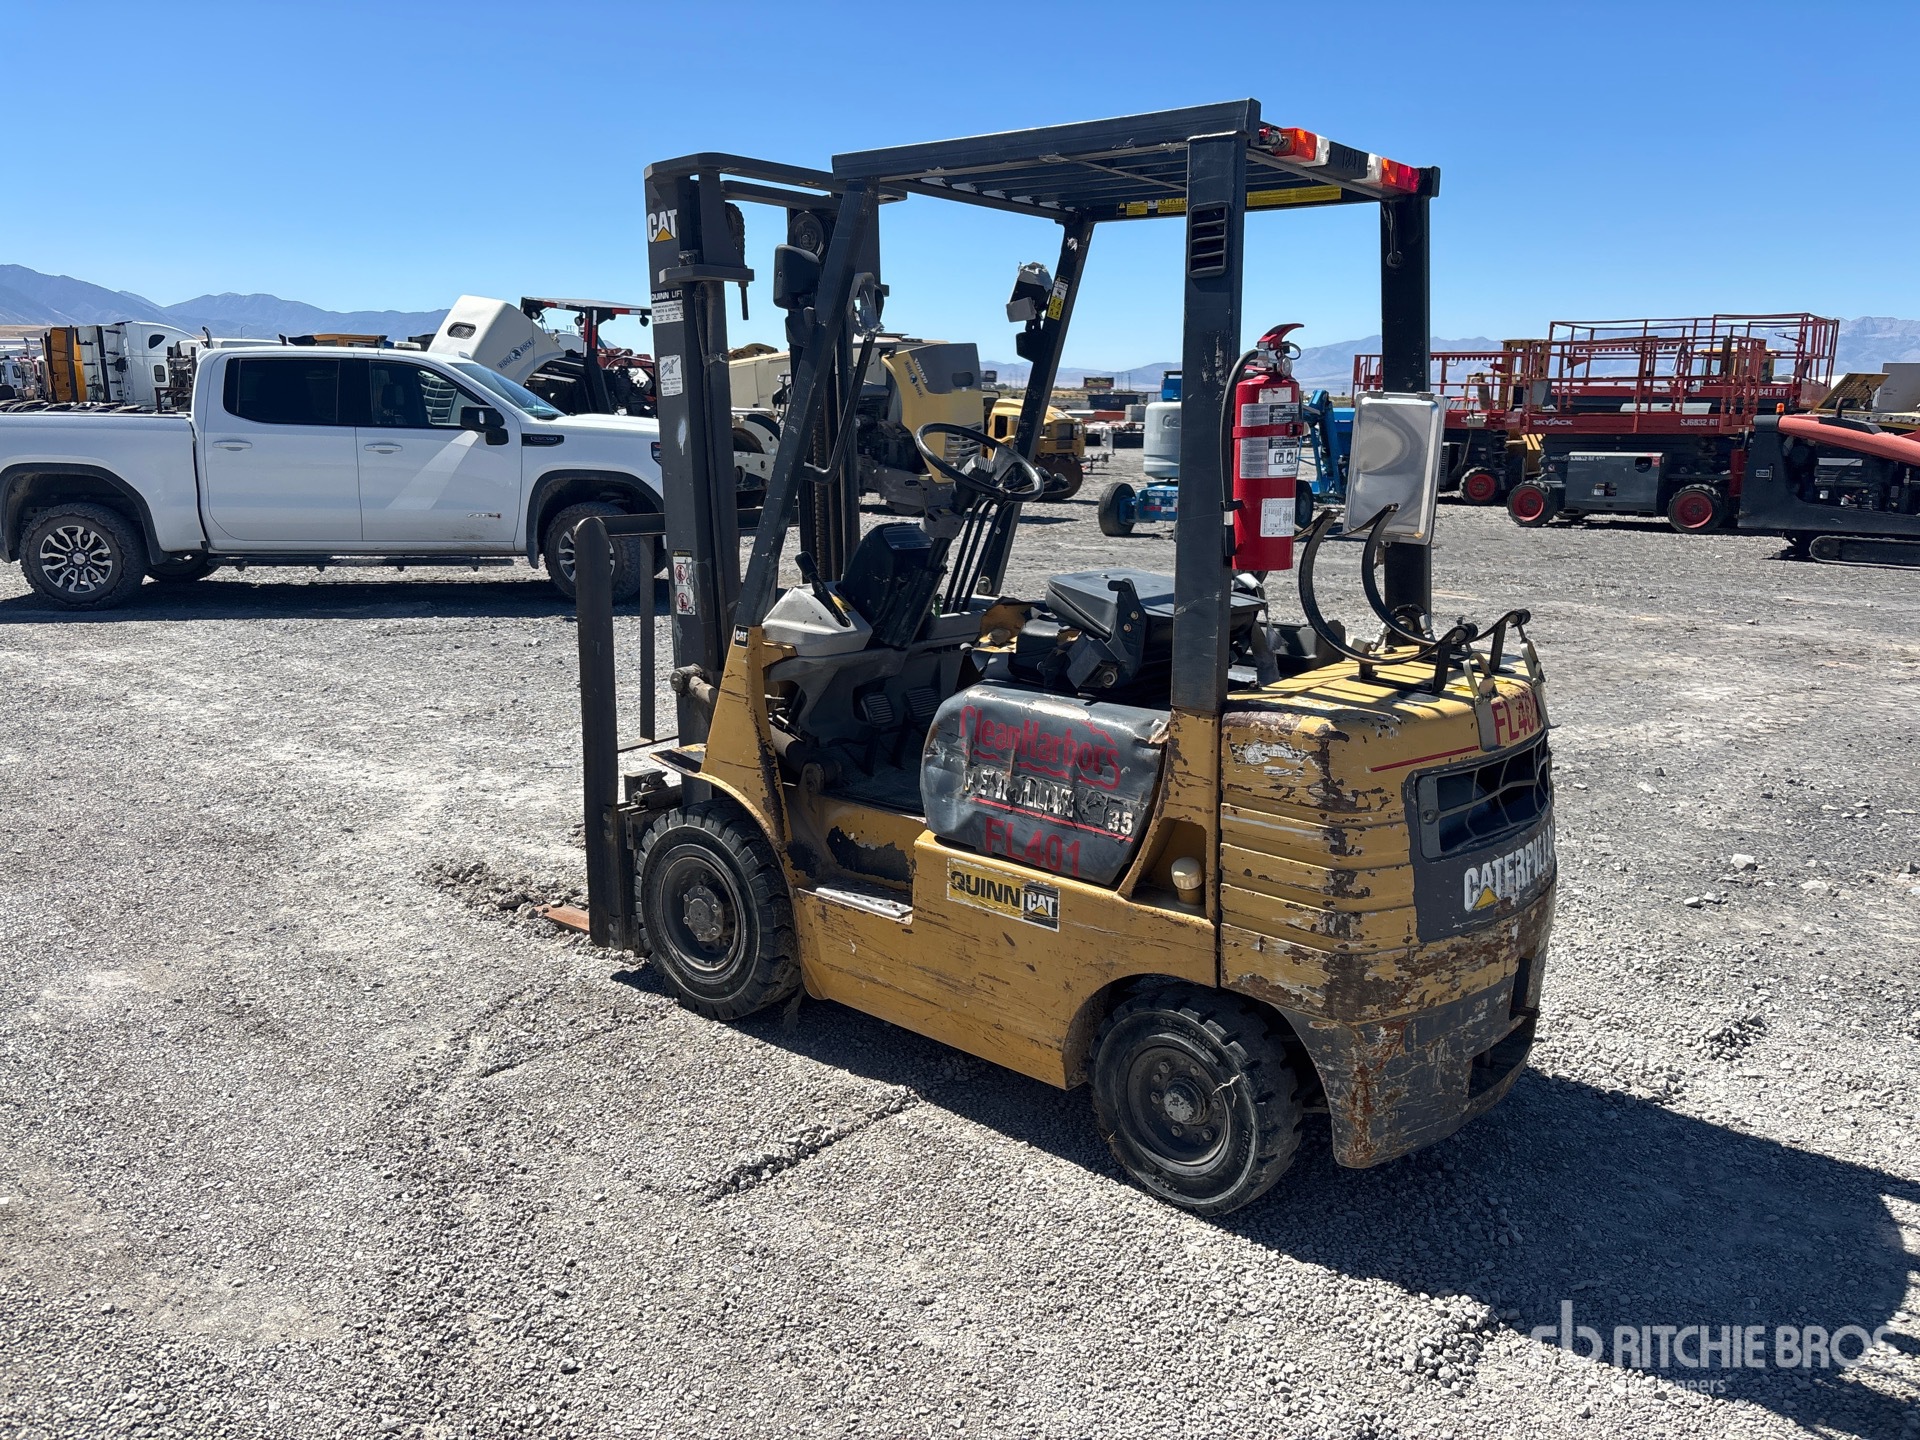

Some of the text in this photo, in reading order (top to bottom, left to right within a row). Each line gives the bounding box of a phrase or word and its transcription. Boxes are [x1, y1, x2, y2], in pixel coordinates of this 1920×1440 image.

[647, 208, 678, 243] CAT
[498, 340, 534, 369] RIDGE ROCK
[914, 357, 929, 384] VOLVO
[1775, 388, 1787, 396] RT
[1532, 417, 1573, 426] SKYJACK
[1708, 418, 1719, 426] RT
[736, 630, 748, 642] CAT
[1107, 808, 1134, 836] 35
[984, 816, 1081, 878] FL401
[949, 870, 1057, 918] QUINN CAT
